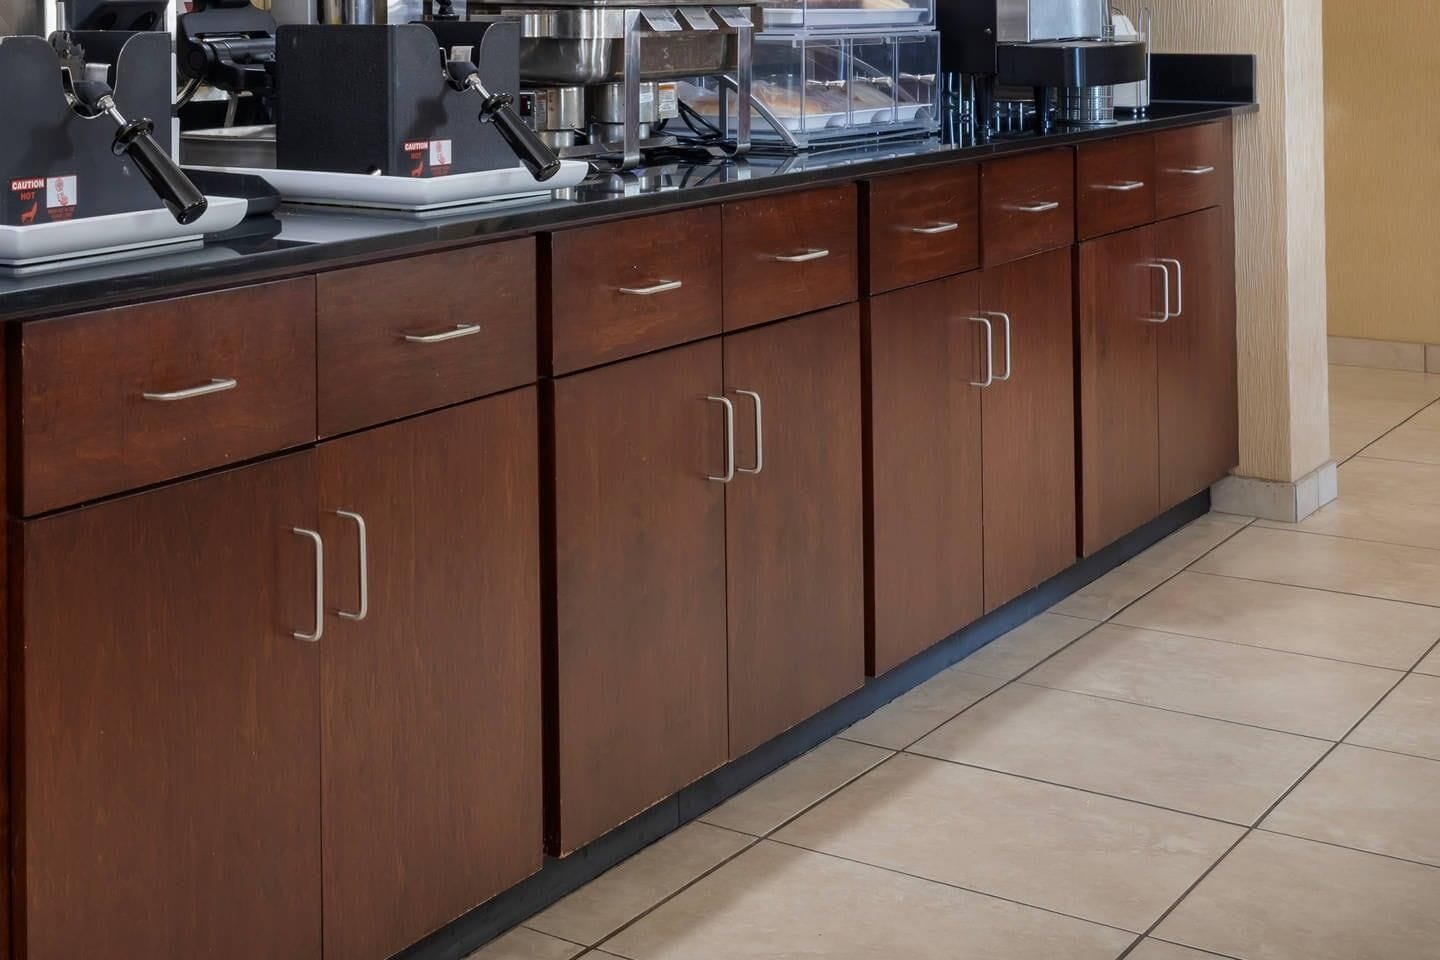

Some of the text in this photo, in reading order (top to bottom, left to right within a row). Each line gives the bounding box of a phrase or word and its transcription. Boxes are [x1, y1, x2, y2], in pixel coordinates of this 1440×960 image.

[404, 142, 429, 151] CAUTION
[12, 178, 45, 191] CAUTION
[20, 191, 36, 201] HOT
